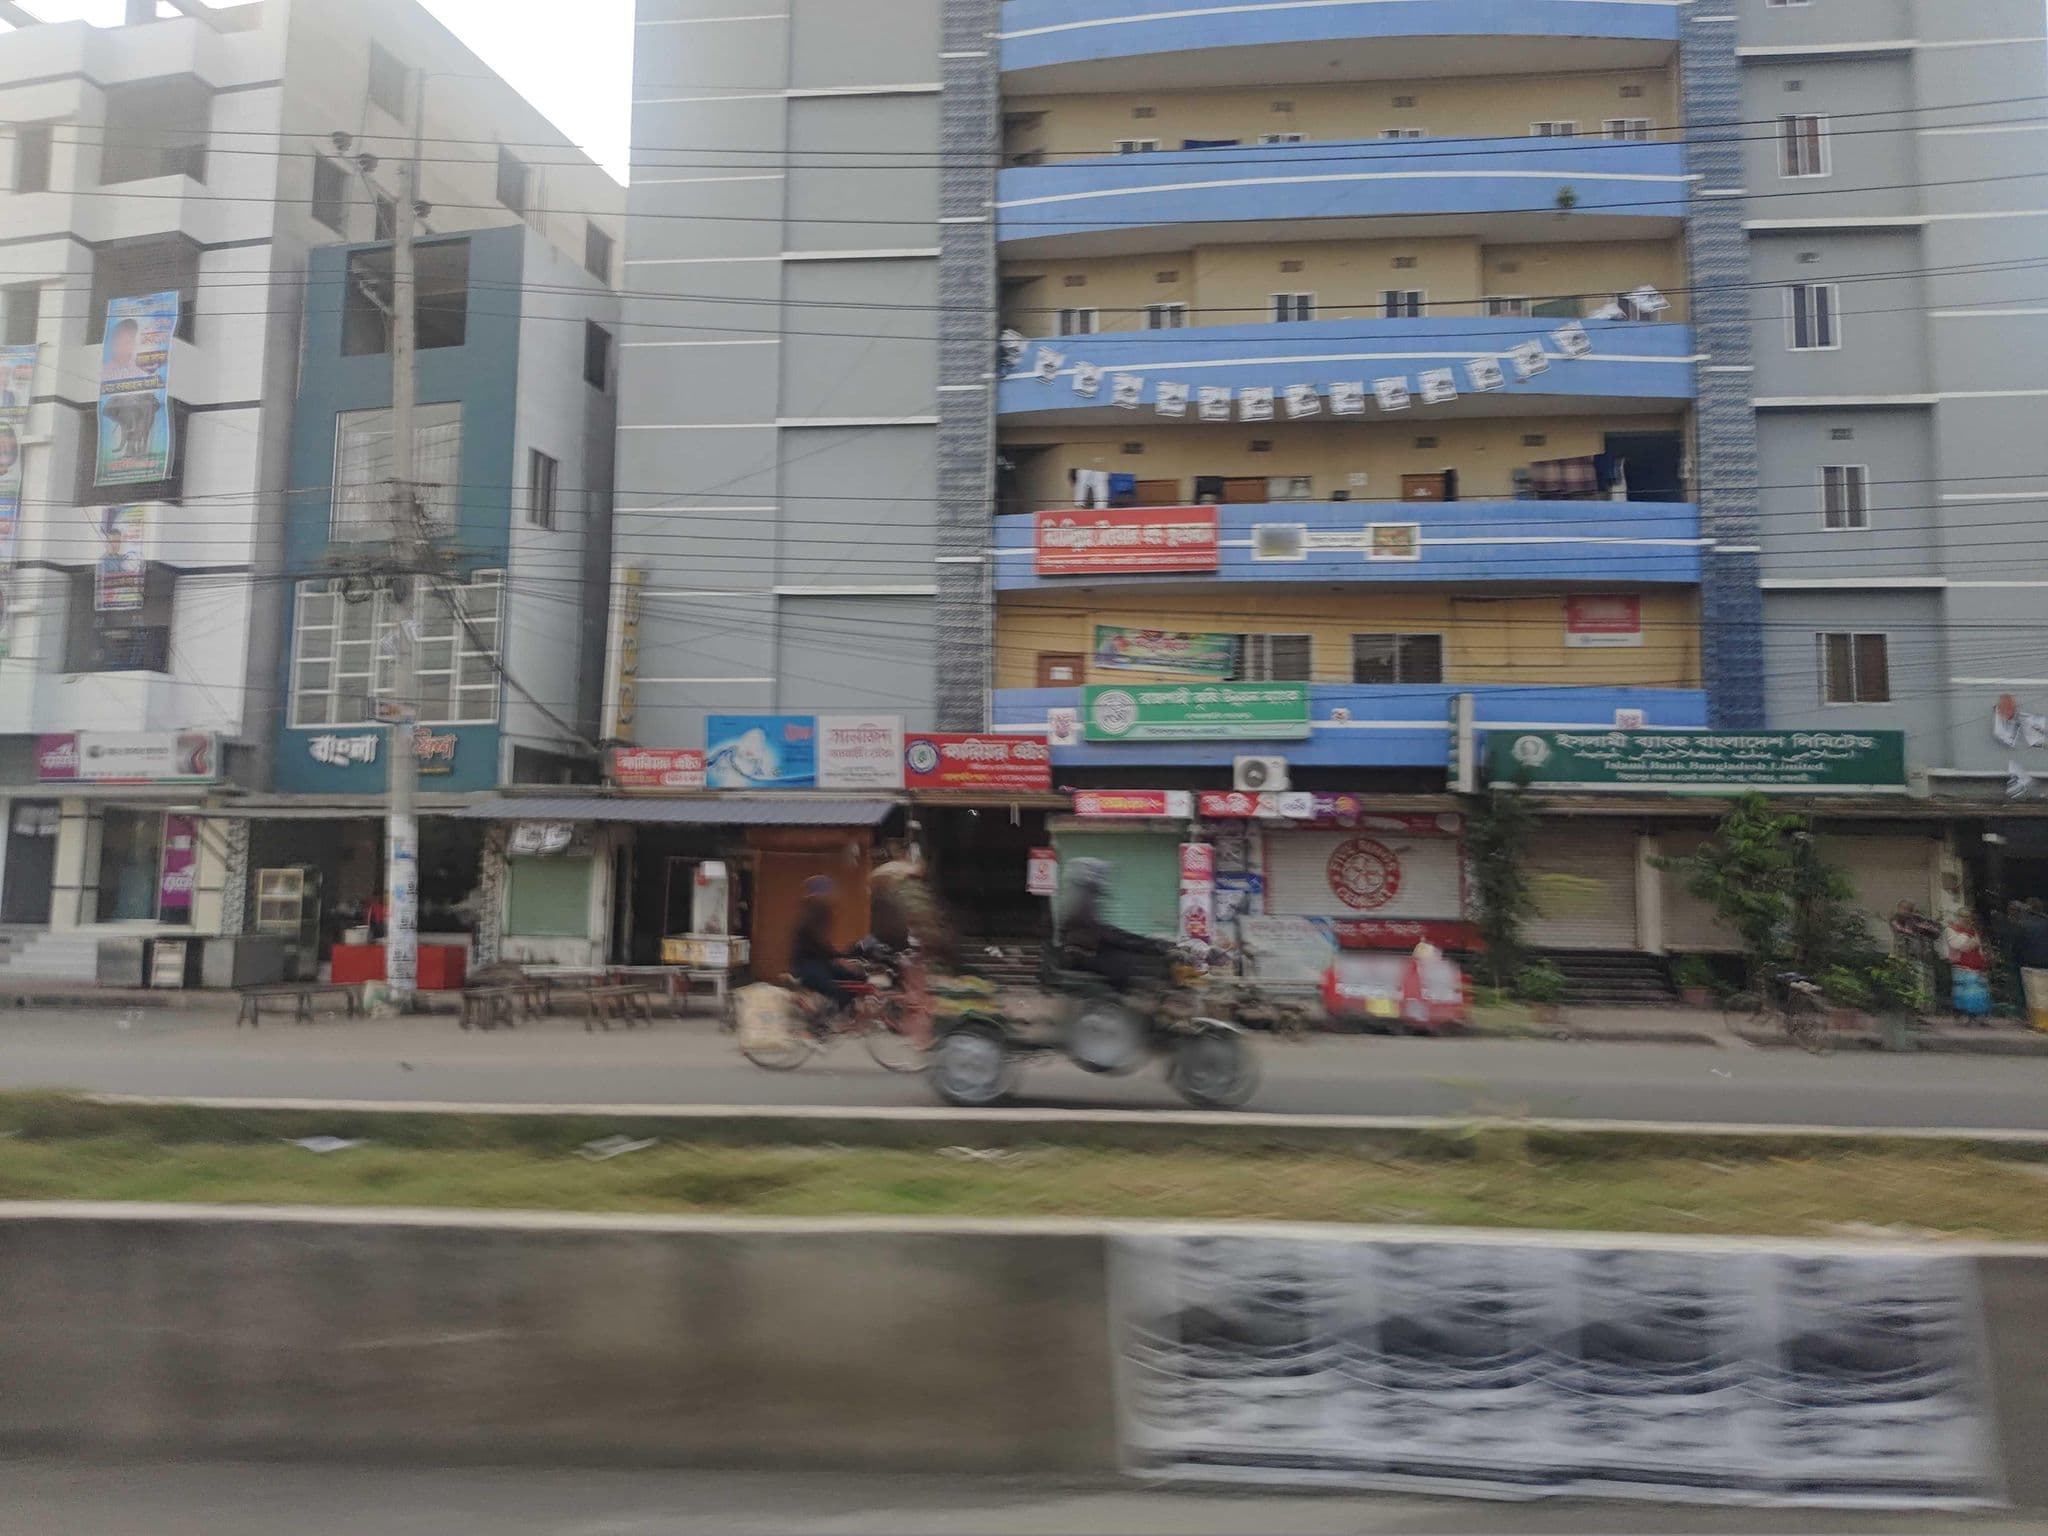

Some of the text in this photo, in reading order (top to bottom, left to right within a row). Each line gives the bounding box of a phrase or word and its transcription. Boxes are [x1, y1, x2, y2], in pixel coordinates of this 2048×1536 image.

[1555, 732, 1875, 750] ইসলামী ব্যাংক বাংলাদেশ লিমিটেড
[307, 734, 379, 767] বাংলা
[1604, 761, 1825, 771] Islami Bank Bangladesh Limited
